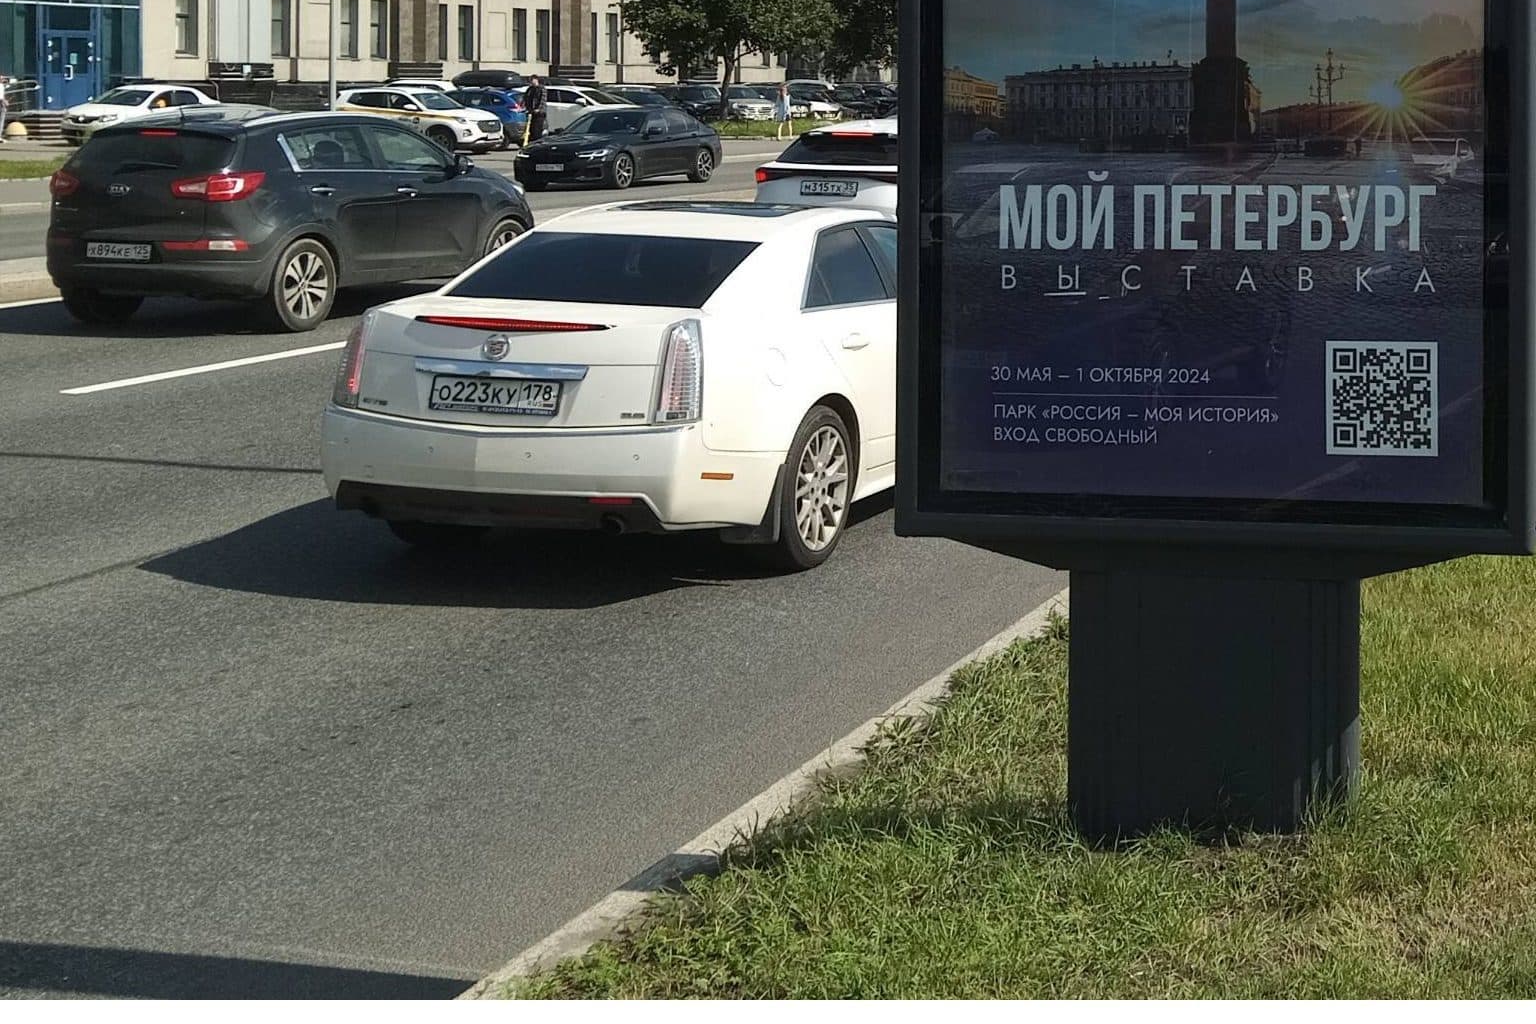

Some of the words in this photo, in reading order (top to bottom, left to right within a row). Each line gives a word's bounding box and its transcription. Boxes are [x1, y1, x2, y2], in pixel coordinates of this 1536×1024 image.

[1000, 171, 1114, 250] МОЙ
[1134, 184, 1437, 251] ПЕТЕРБУРГ
[1001, 265, 1436, 293] ВЫСТАВКА
[991, 366, 1011, 381] 30
[1016, 366, 1052, 382] МАЯ
[1076, 367, 1083, 382] 1
[1089, 367, 1162, 383] ОКТЯБРЯ
[1168, 368, 1211, 384] 2024
[523, 384, 553, 401] 178
[994, 404, 1037, 419] ПАРК
[1042, 405, 1121, 420] «РОССИЯ
[1144, 407, 1182, 422] МОЯ
[1188, 407, 1280, 423] ИСТОРИЯ»
[993, 426, 1040, 444] ВХОД
[1045, 425, 1158, 445] СВОБОДНЫЙ
